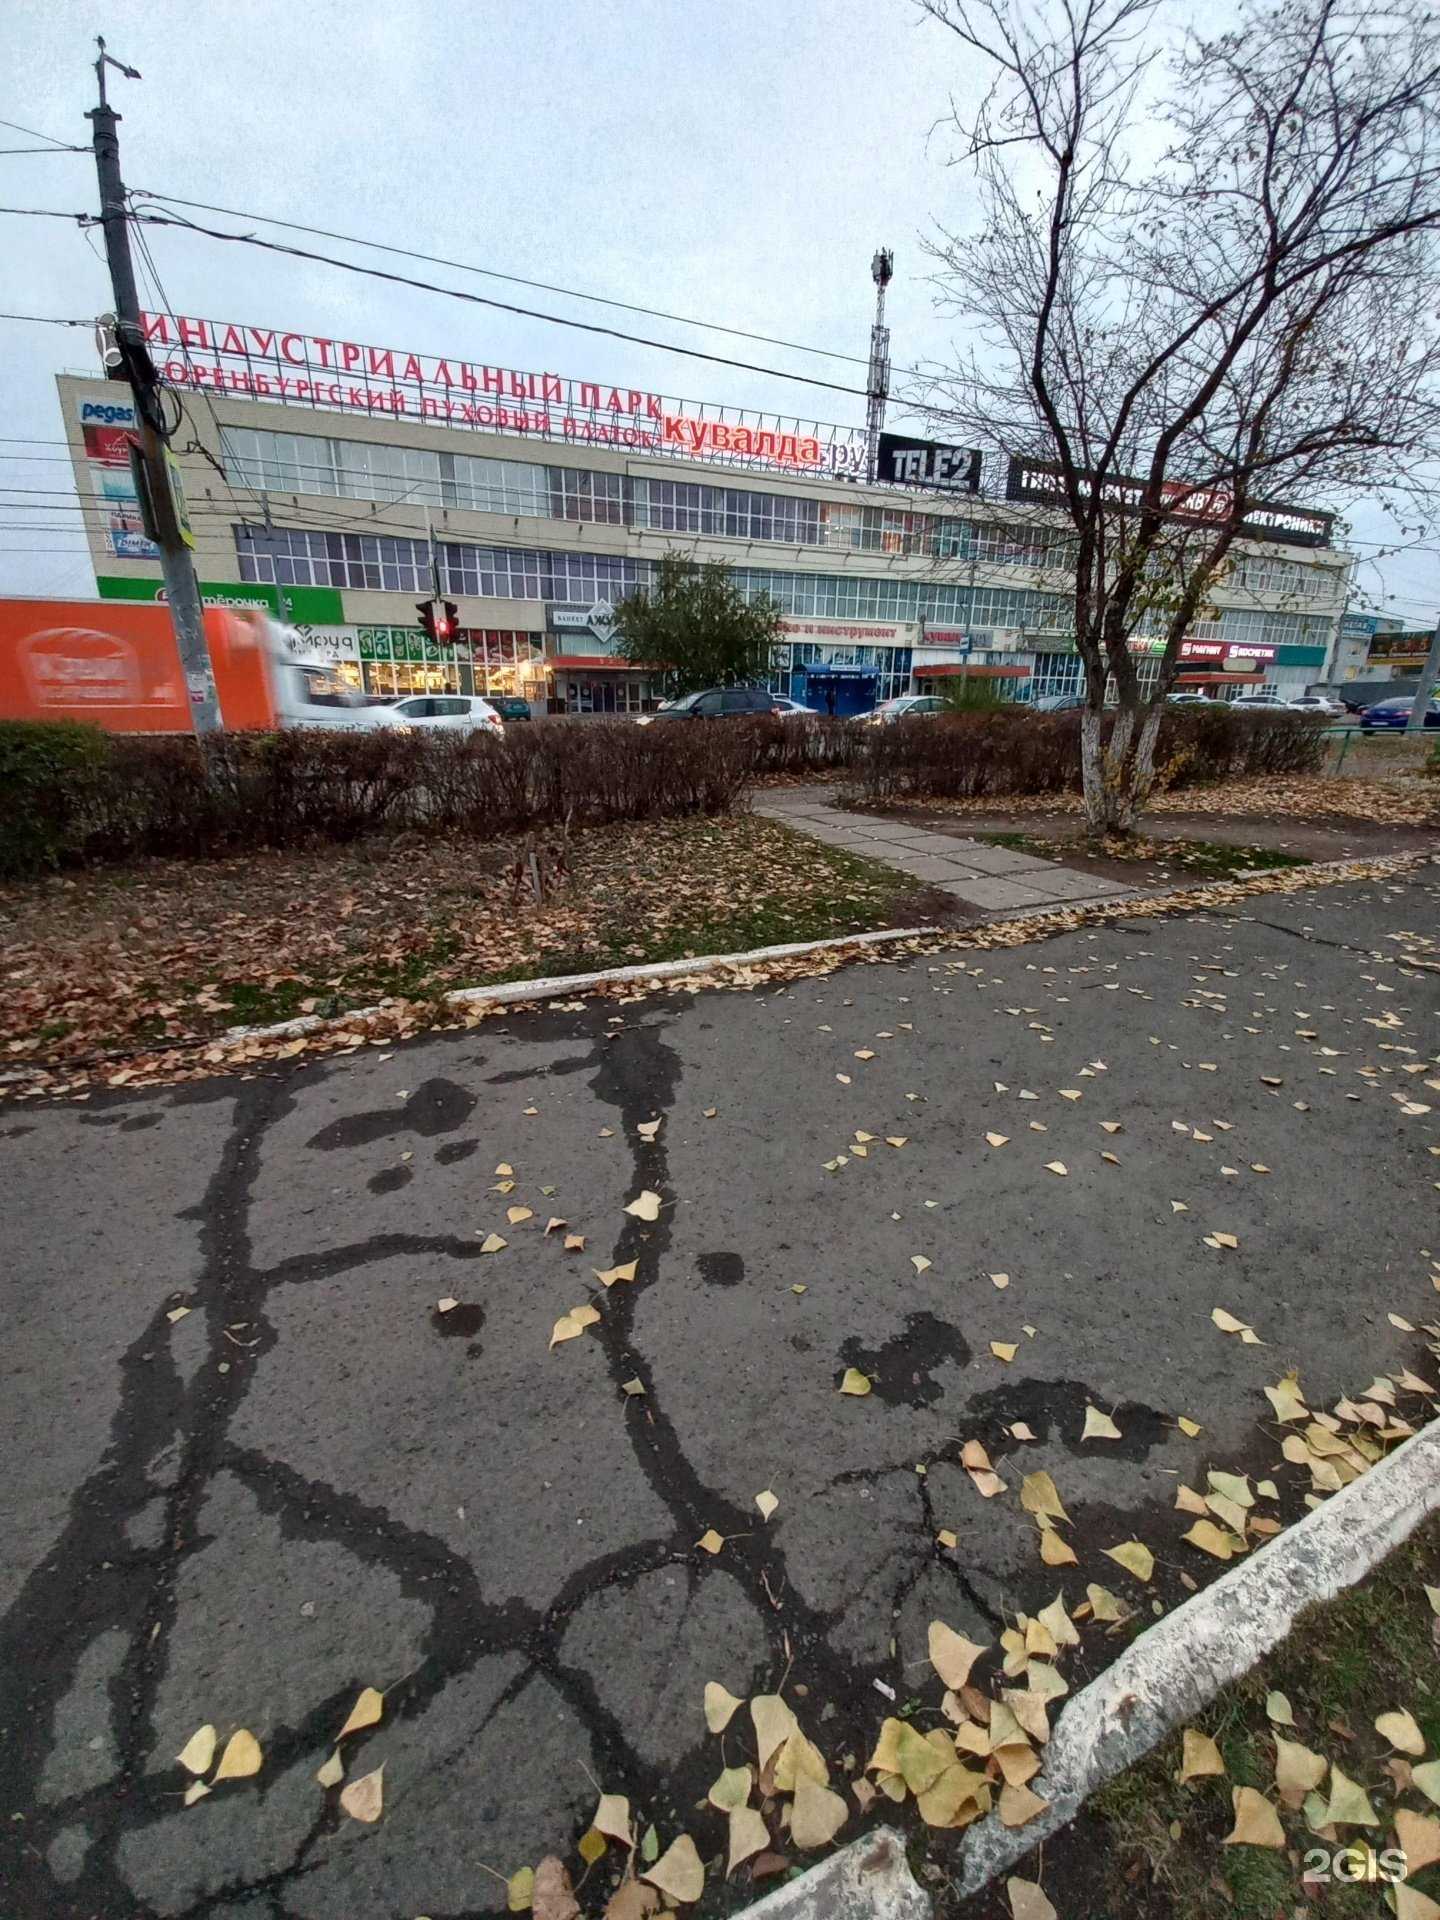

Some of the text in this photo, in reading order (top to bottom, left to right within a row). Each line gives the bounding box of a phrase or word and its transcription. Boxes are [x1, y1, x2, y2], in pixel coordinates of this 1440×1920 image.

[138, 311, 663, 419] ИНДУСТРИАЛЬНЫЙ ПАРК
[82, 403, 134, 423] pegas
[165, 361, 653, 448] ОРЕНБУРГСКИЙ ПУХОВЫЙ ПЛАТОК
[892, 448, 973, 488] TELE2
